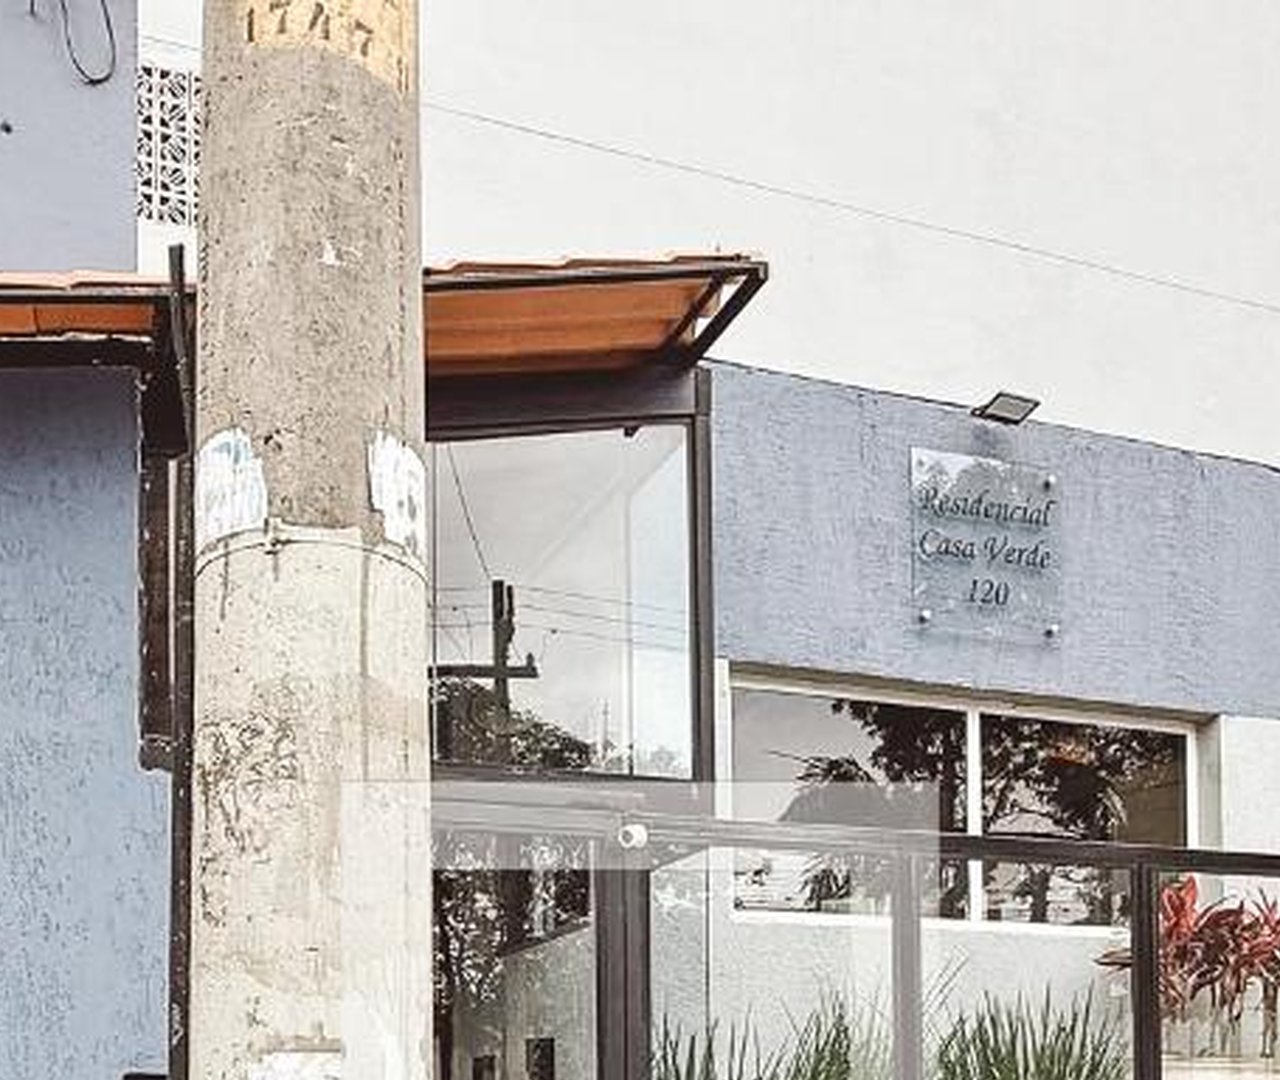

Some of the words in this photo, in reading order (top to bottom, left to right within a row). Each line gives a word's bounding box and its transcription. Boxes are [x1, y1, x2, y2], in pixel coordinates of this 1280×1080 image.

[920, 487, 1056, 526] Residencial
[920, 529, 975, 561] Casa
[983, 536, 1050, 568] Verde
[968, 578, 1009, 605] 120
